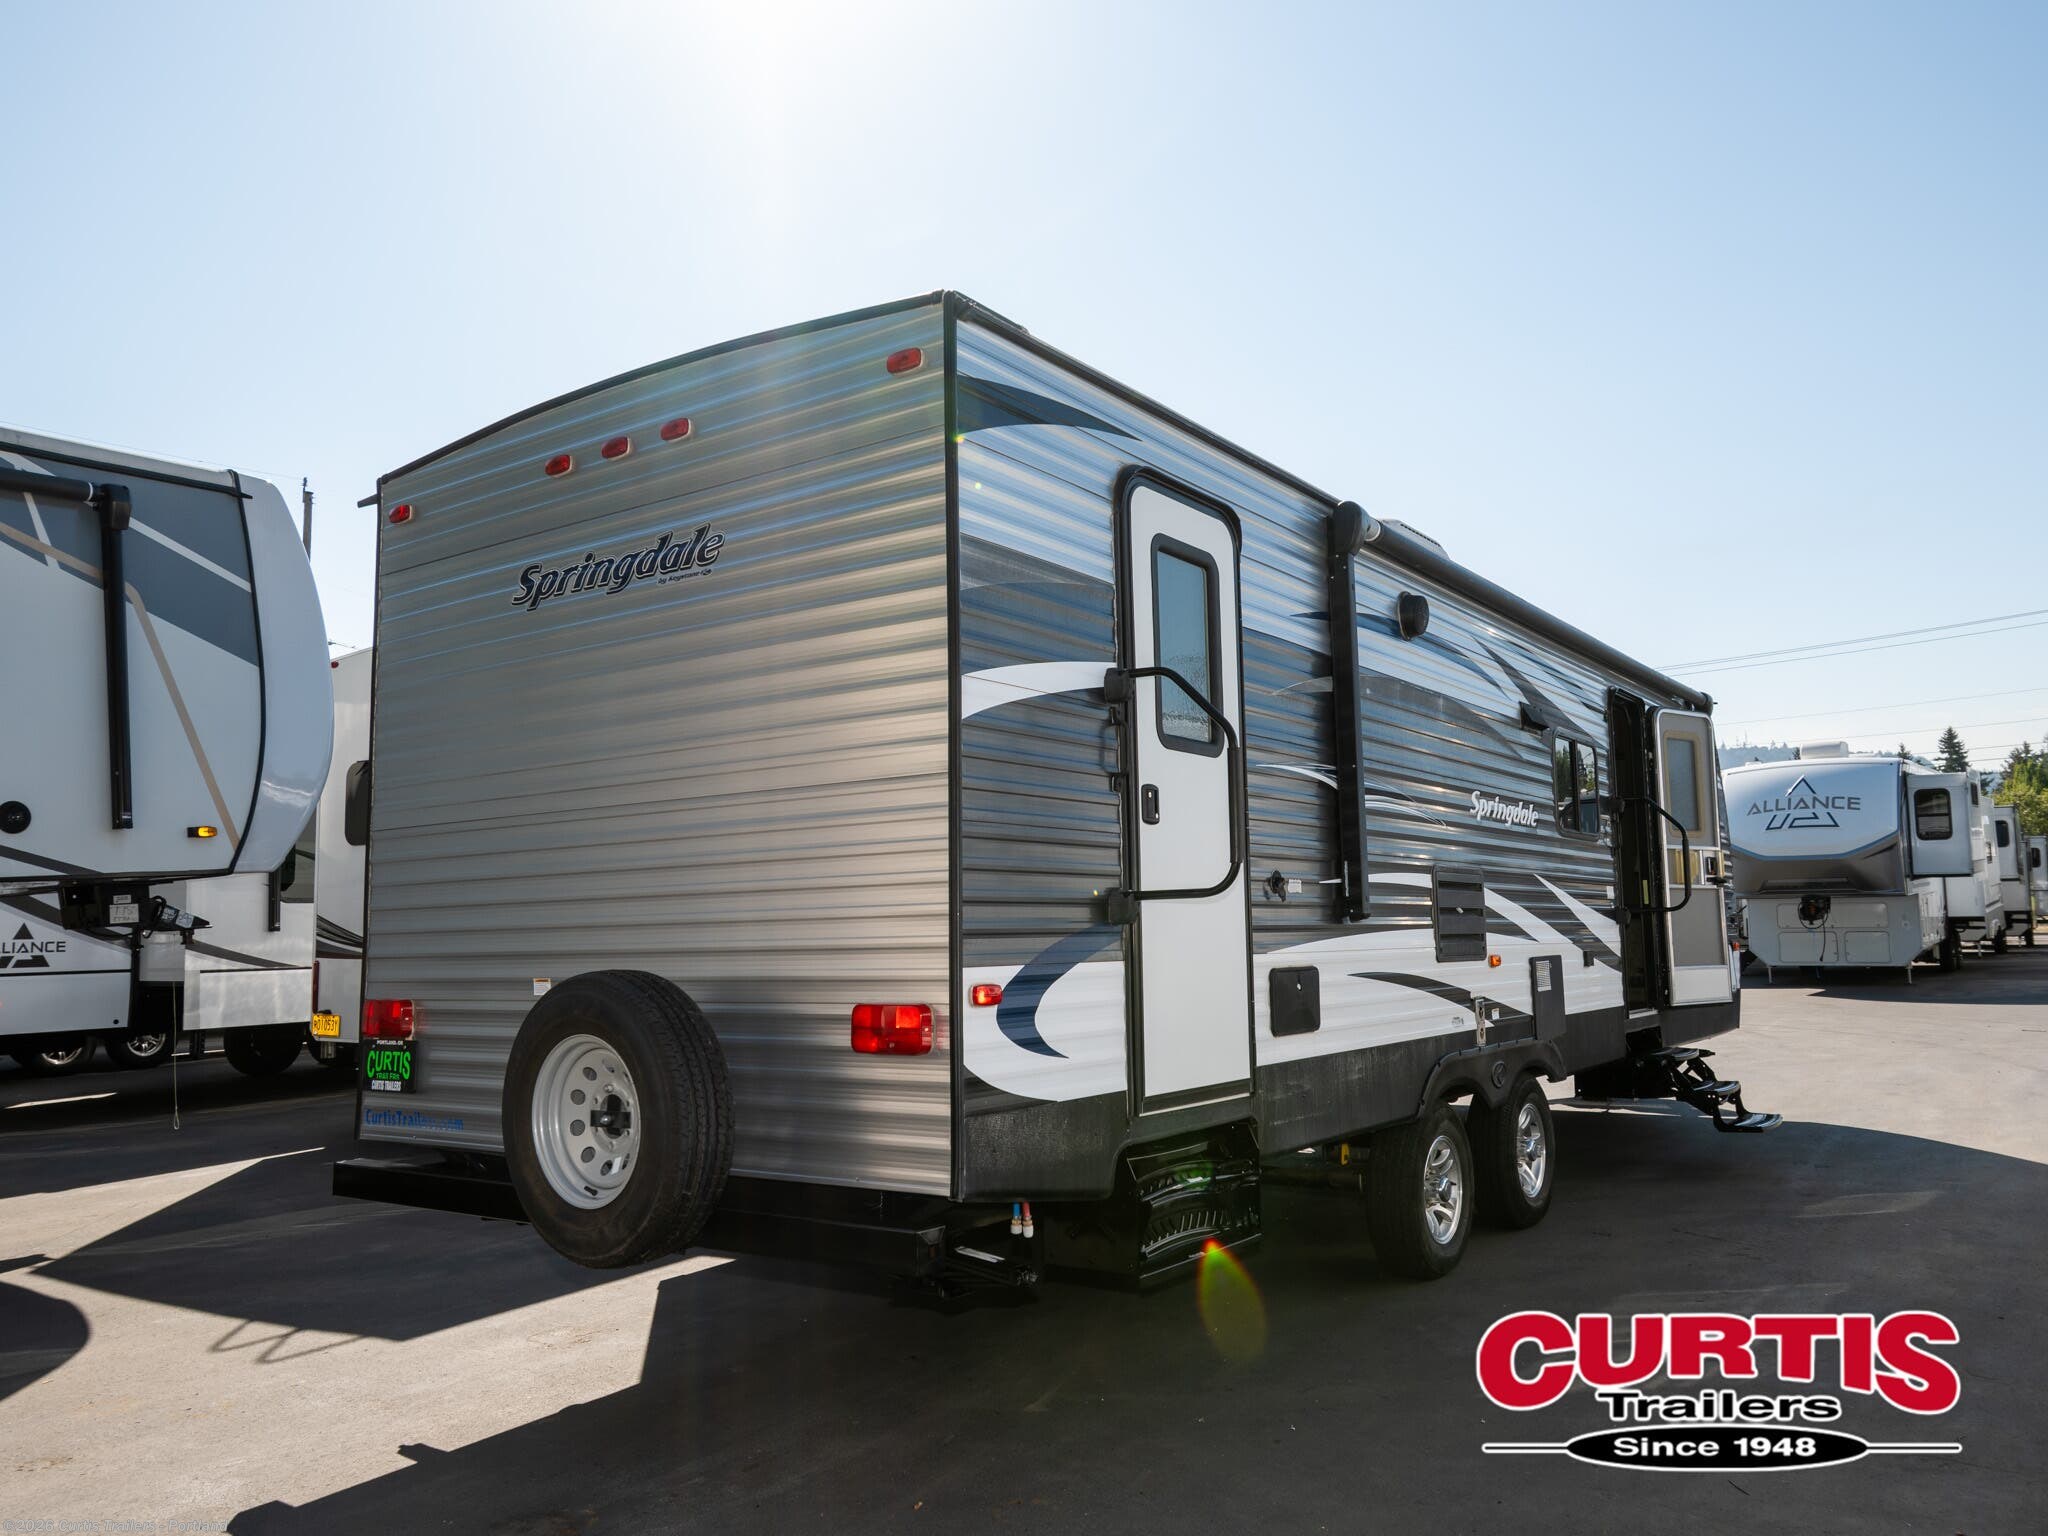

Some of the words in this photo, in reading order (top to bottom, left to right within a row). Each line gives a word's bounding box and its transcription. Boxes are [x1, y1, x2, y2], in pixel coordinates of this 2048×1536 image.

[512, 523, 727, 611] Springdale
[1470, 790, 1538, 827] Springdale
[1747, 796, 1861, 816] ALLIANCE
[0, 941, 66, 954] LIANCE
[367, 1051, 411, 1079] CURTIS
